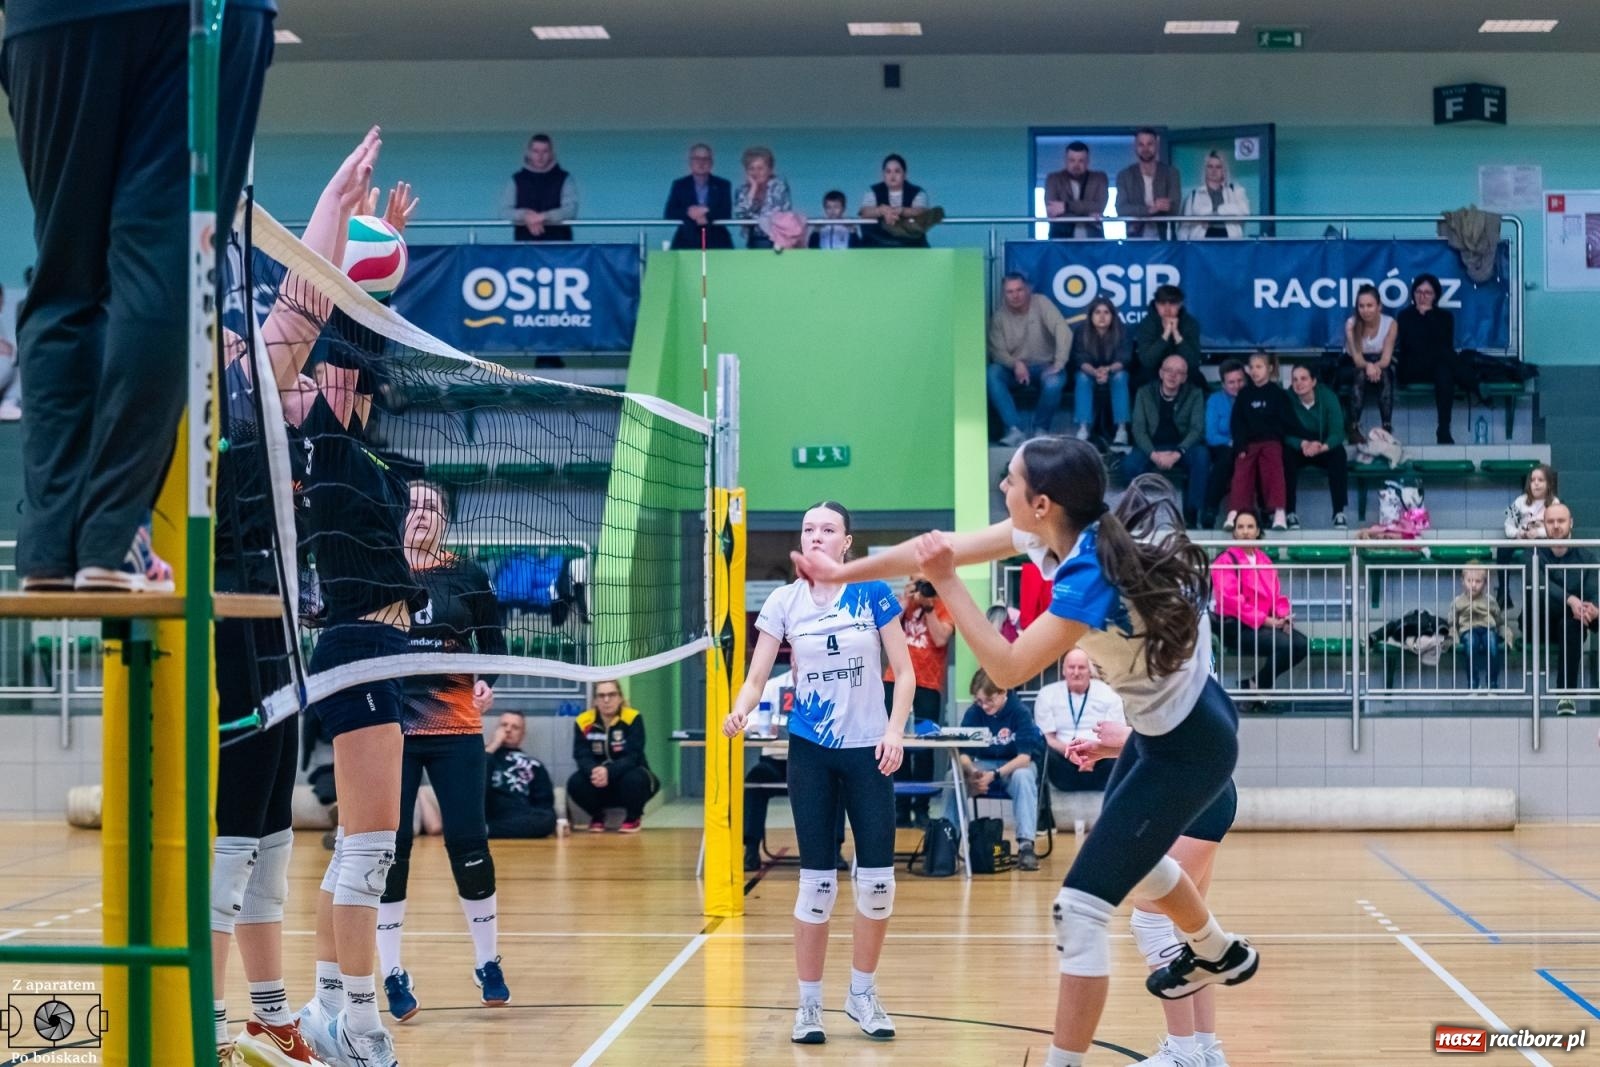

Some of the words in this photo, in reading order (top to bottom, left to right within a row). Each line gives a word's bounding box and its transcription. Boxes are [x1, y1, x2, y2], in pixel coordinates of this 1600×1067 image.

[1445, 97, 1464, 119] F
[1484, 97, 1499, 118] F
[462, 266, 592, 311] OSiR
[513, 311, 592, 327] RACIBÓRZ
[826, 634, 839, 651] 4
[783, 692, 794, 711] 2
